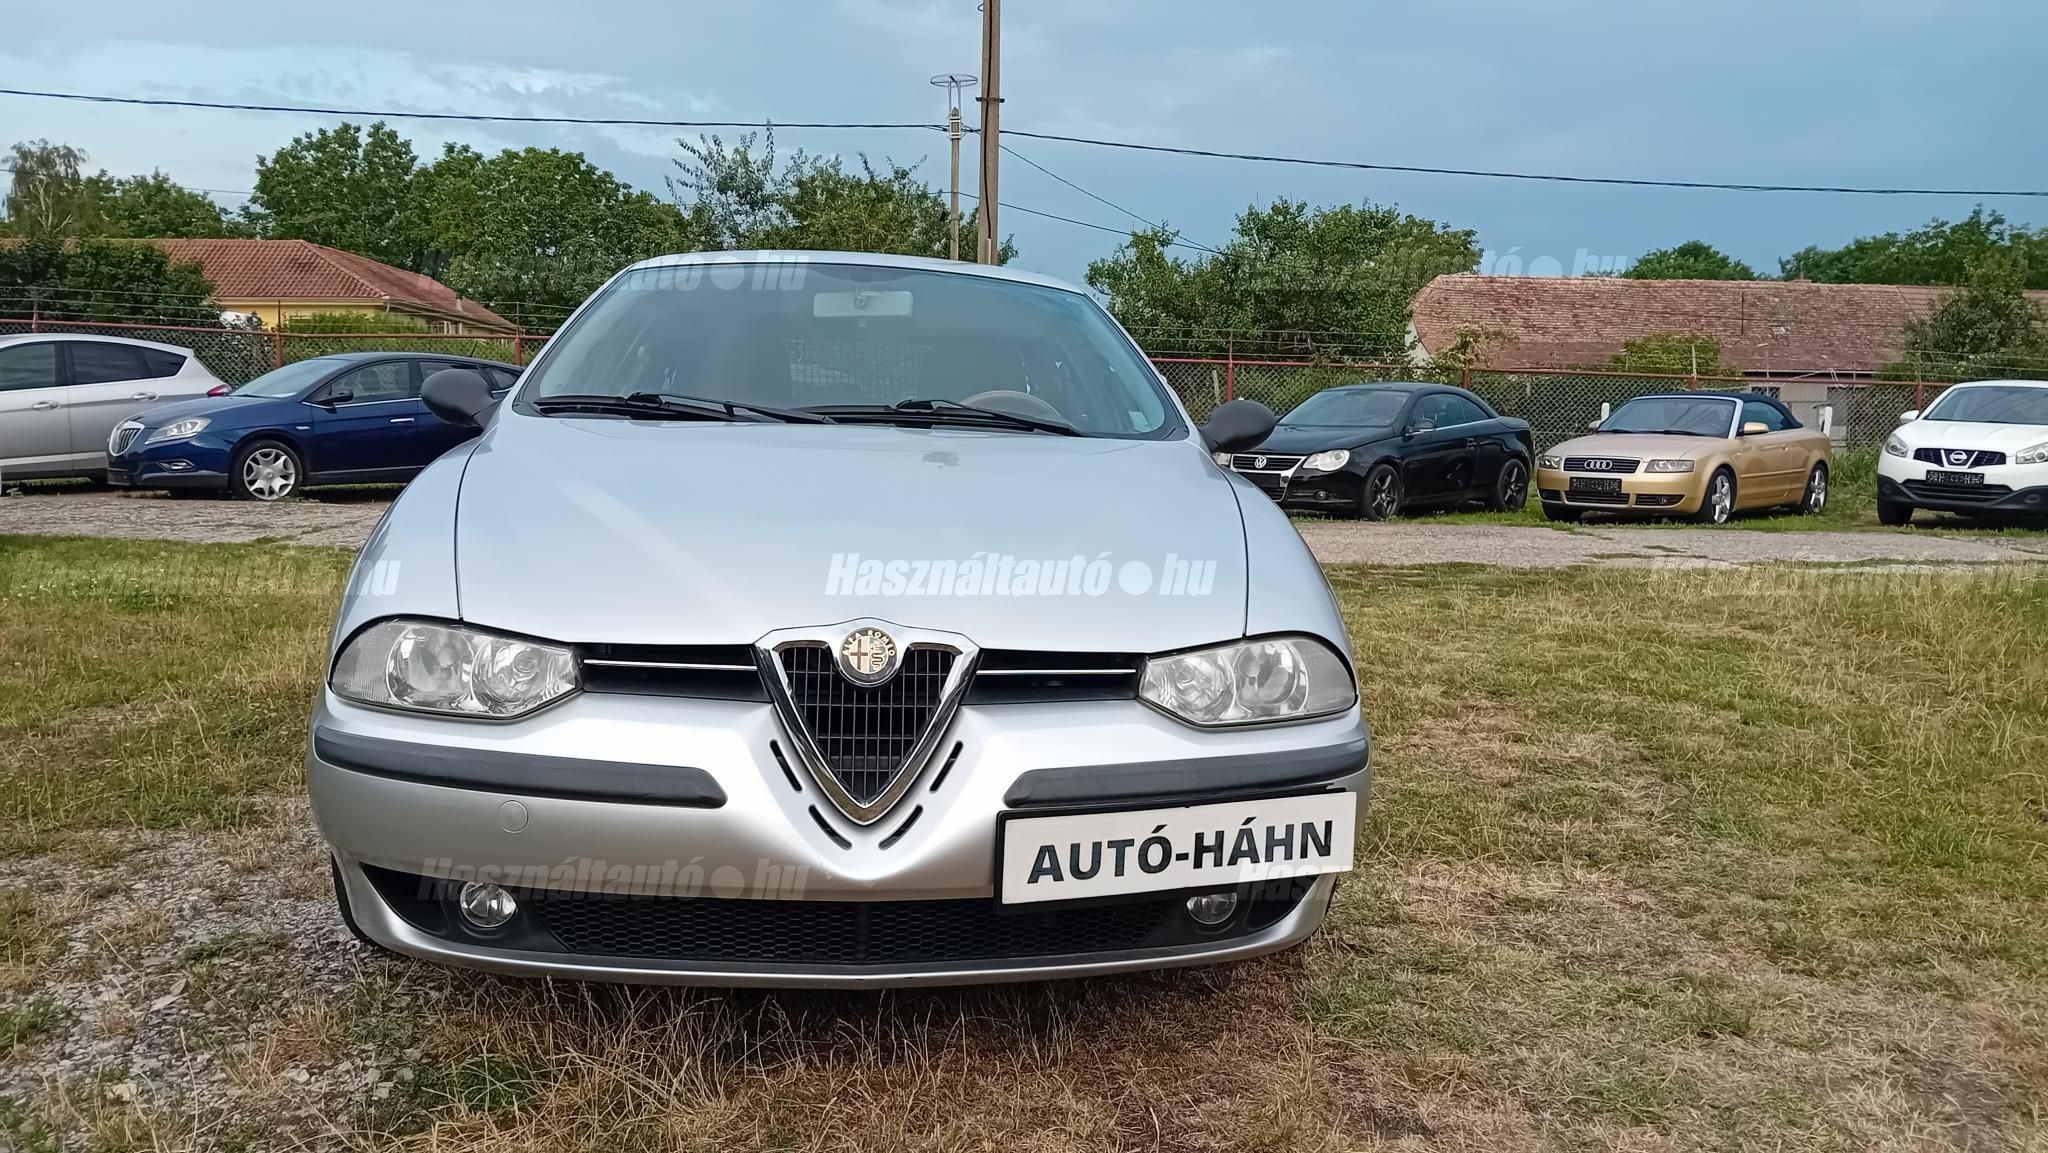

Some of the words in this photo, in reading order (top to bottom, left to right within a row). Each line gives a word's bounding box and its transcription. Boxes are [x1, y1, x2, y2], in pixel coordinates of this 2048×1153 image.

[842, 631, 863, 656] ALFA
[867, 629, 896, 657] ROMEO
[1026, 816, 1334, 885] AUTÓ-HÁHN
